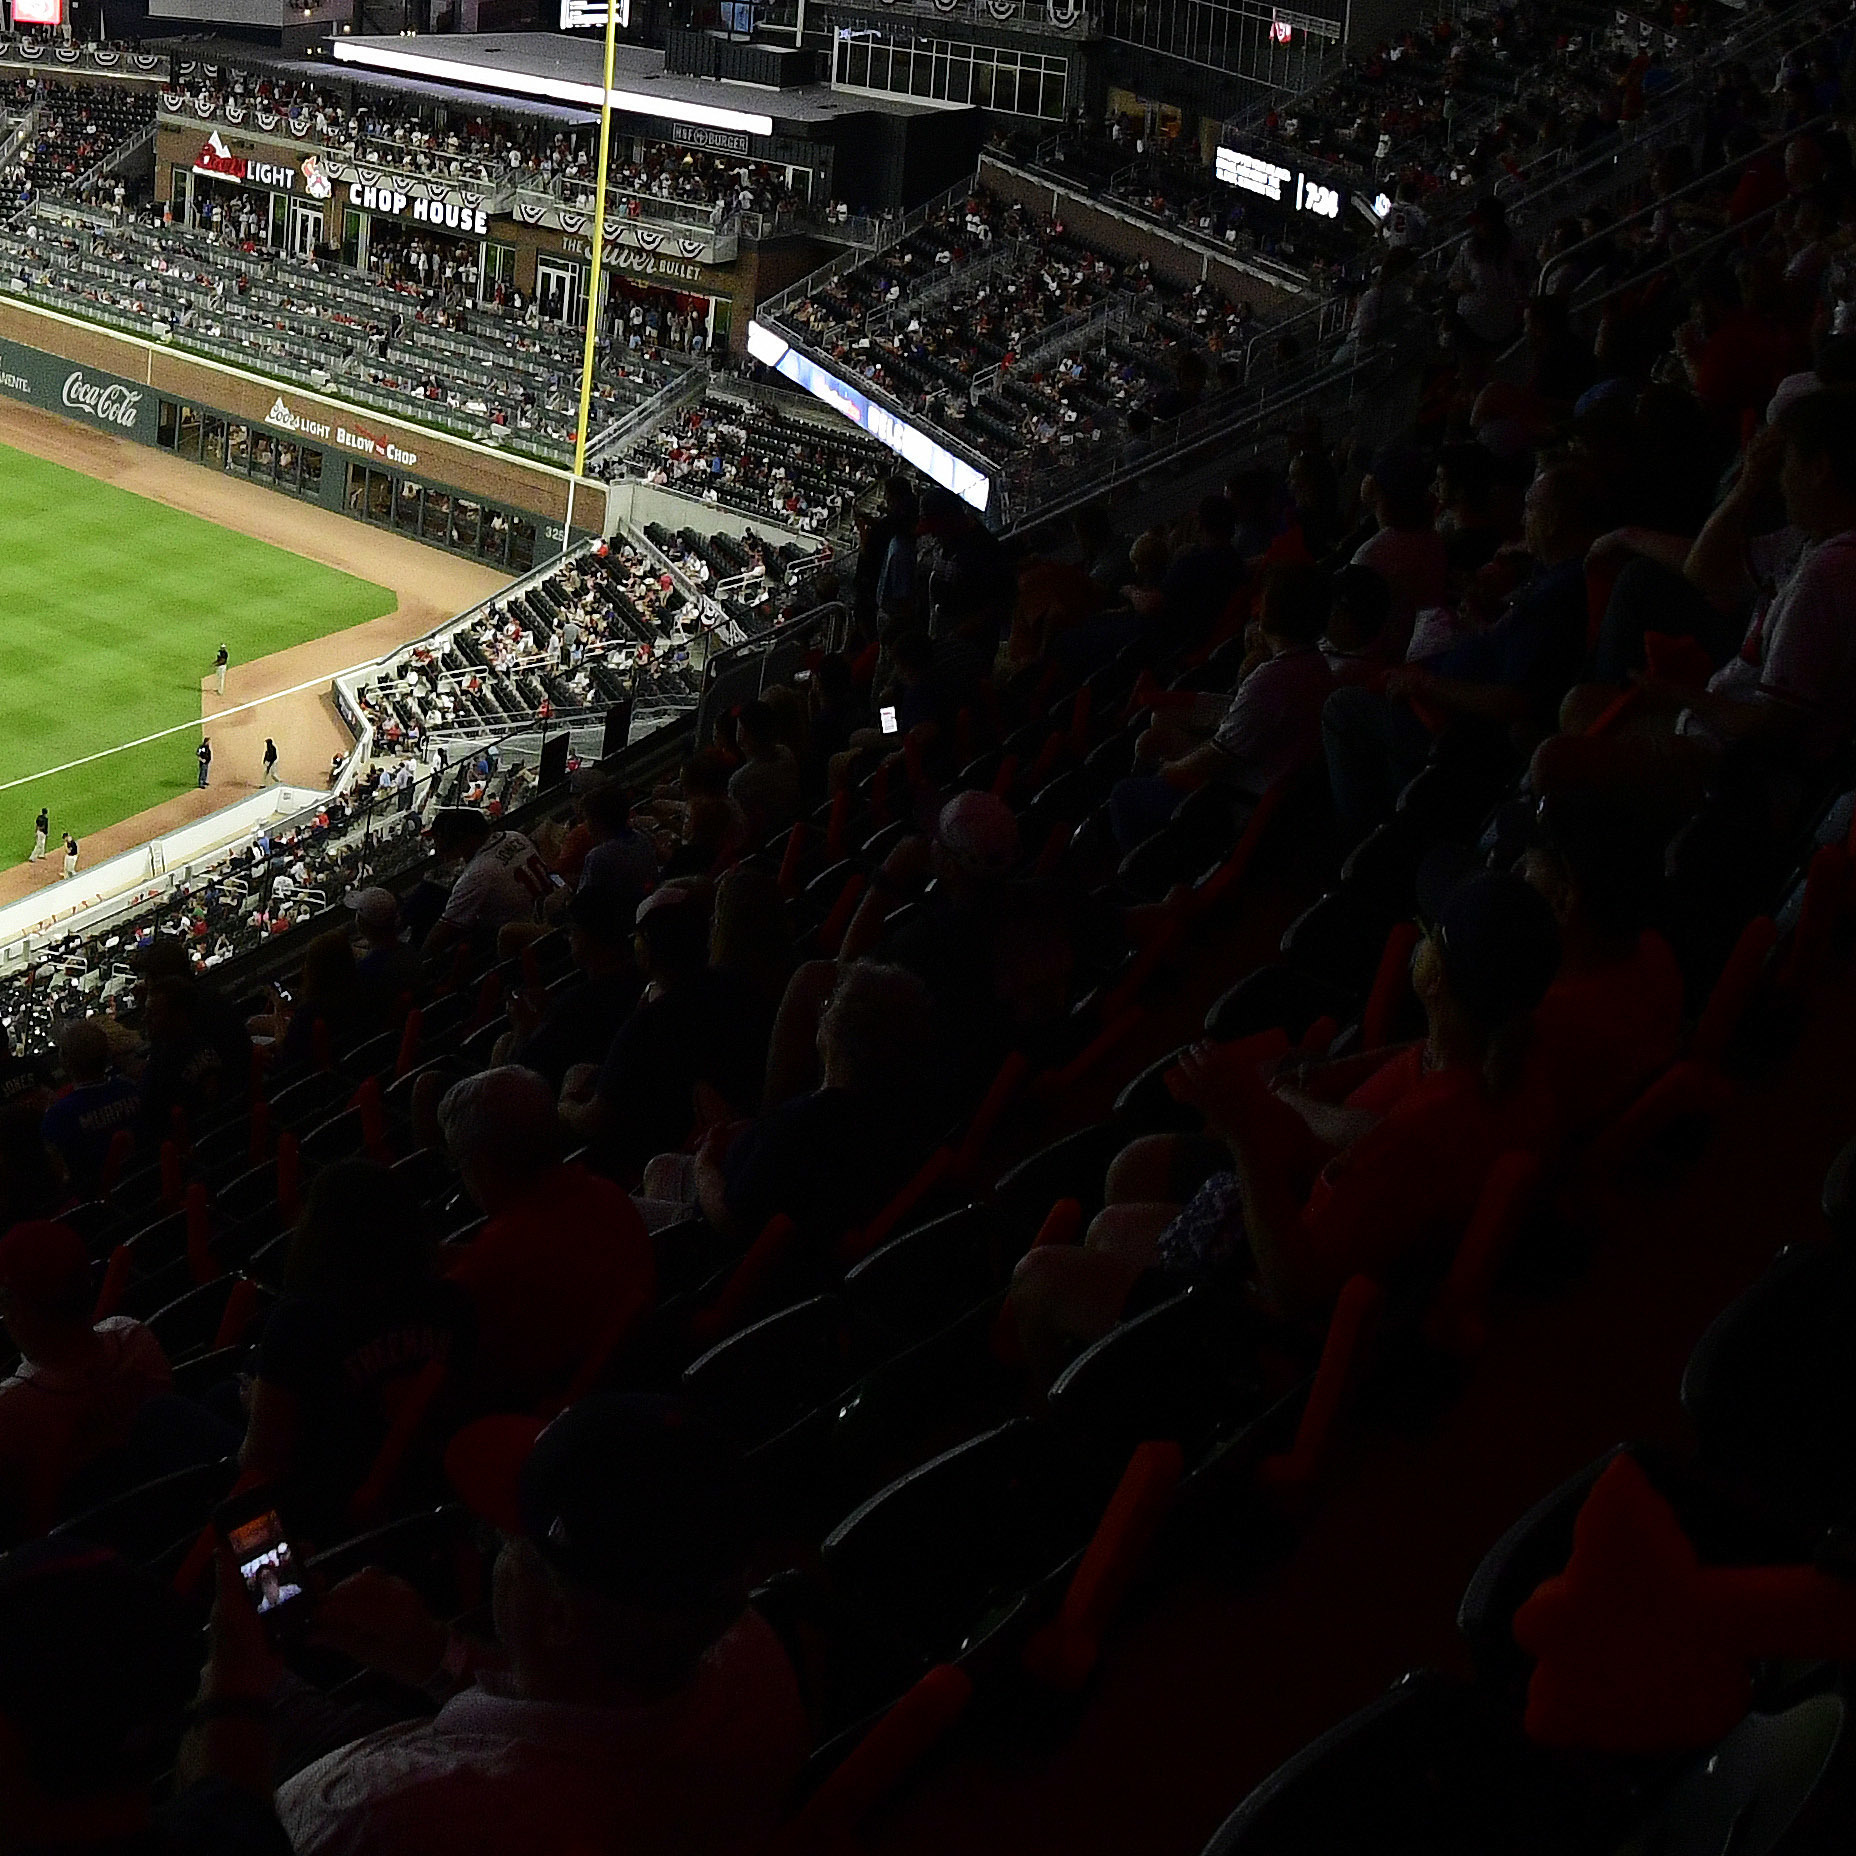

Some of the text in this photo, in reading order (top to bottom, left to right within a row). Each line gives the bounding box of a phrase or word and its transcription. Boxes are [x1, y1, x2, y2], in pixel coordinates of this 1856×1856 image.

[708, 133, 746, 151] BURGER
[246, 160, 488, 235] LIGHT CHOP HOUSE
[562, 237, 701, 280] THE BULLET
[62, 371, 143, 428] Coca-Cola
[300, 419, 330, 439] LIGHT
[337, 428, 374, 453] BELOW
[386, 444, 417, 466] CHOP
[545, 525, 564, 542] 325
